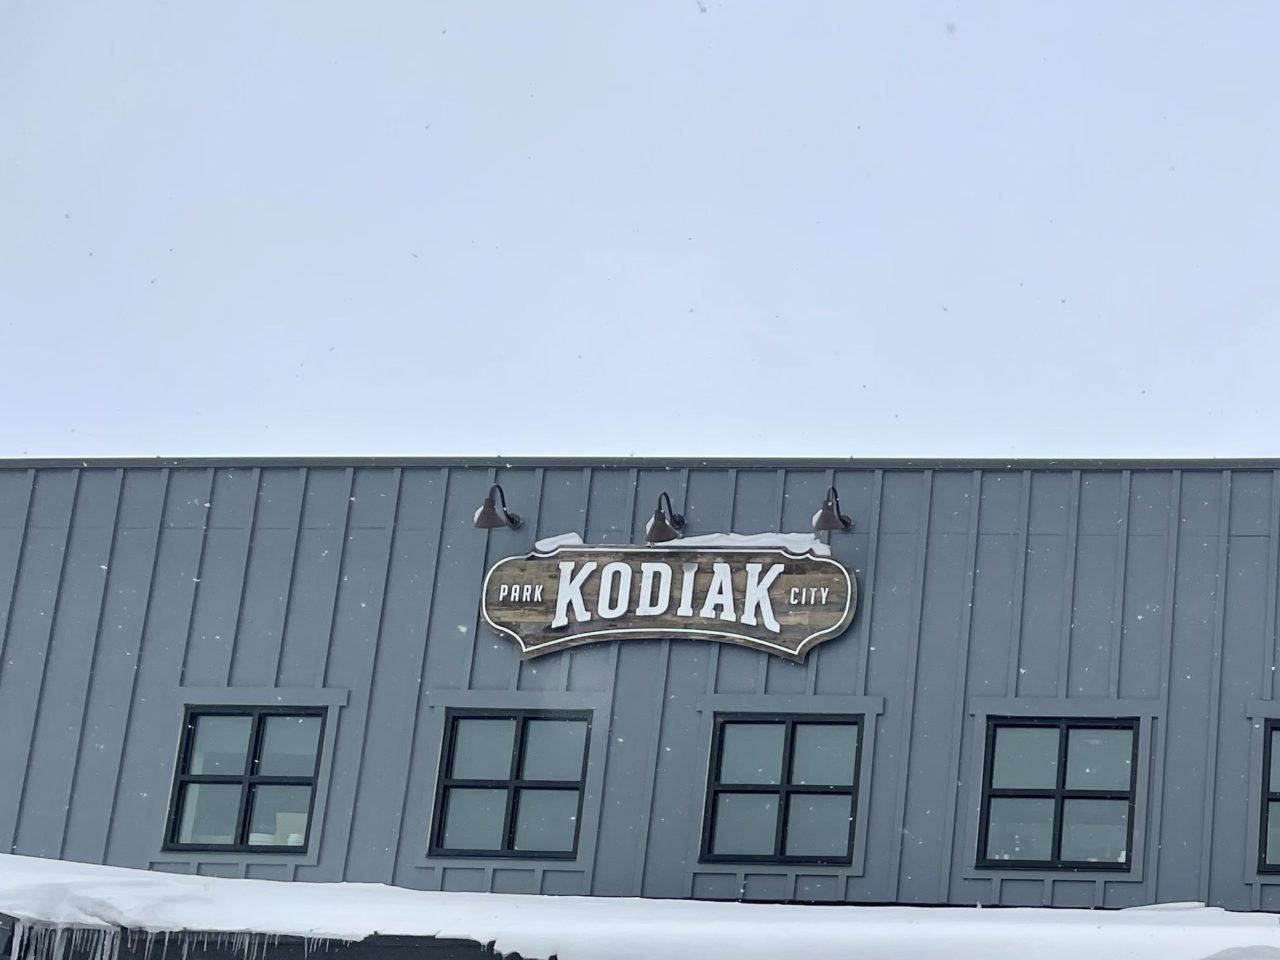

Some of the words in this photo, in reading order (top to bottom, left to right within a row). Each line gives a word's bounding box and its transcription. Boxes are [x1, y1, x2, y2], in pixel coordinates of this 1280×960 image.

[499, 584, 544, 602] PARK
[551, 561, 785, 633] KODIAK
[790, 587, 830, 605] CITY
